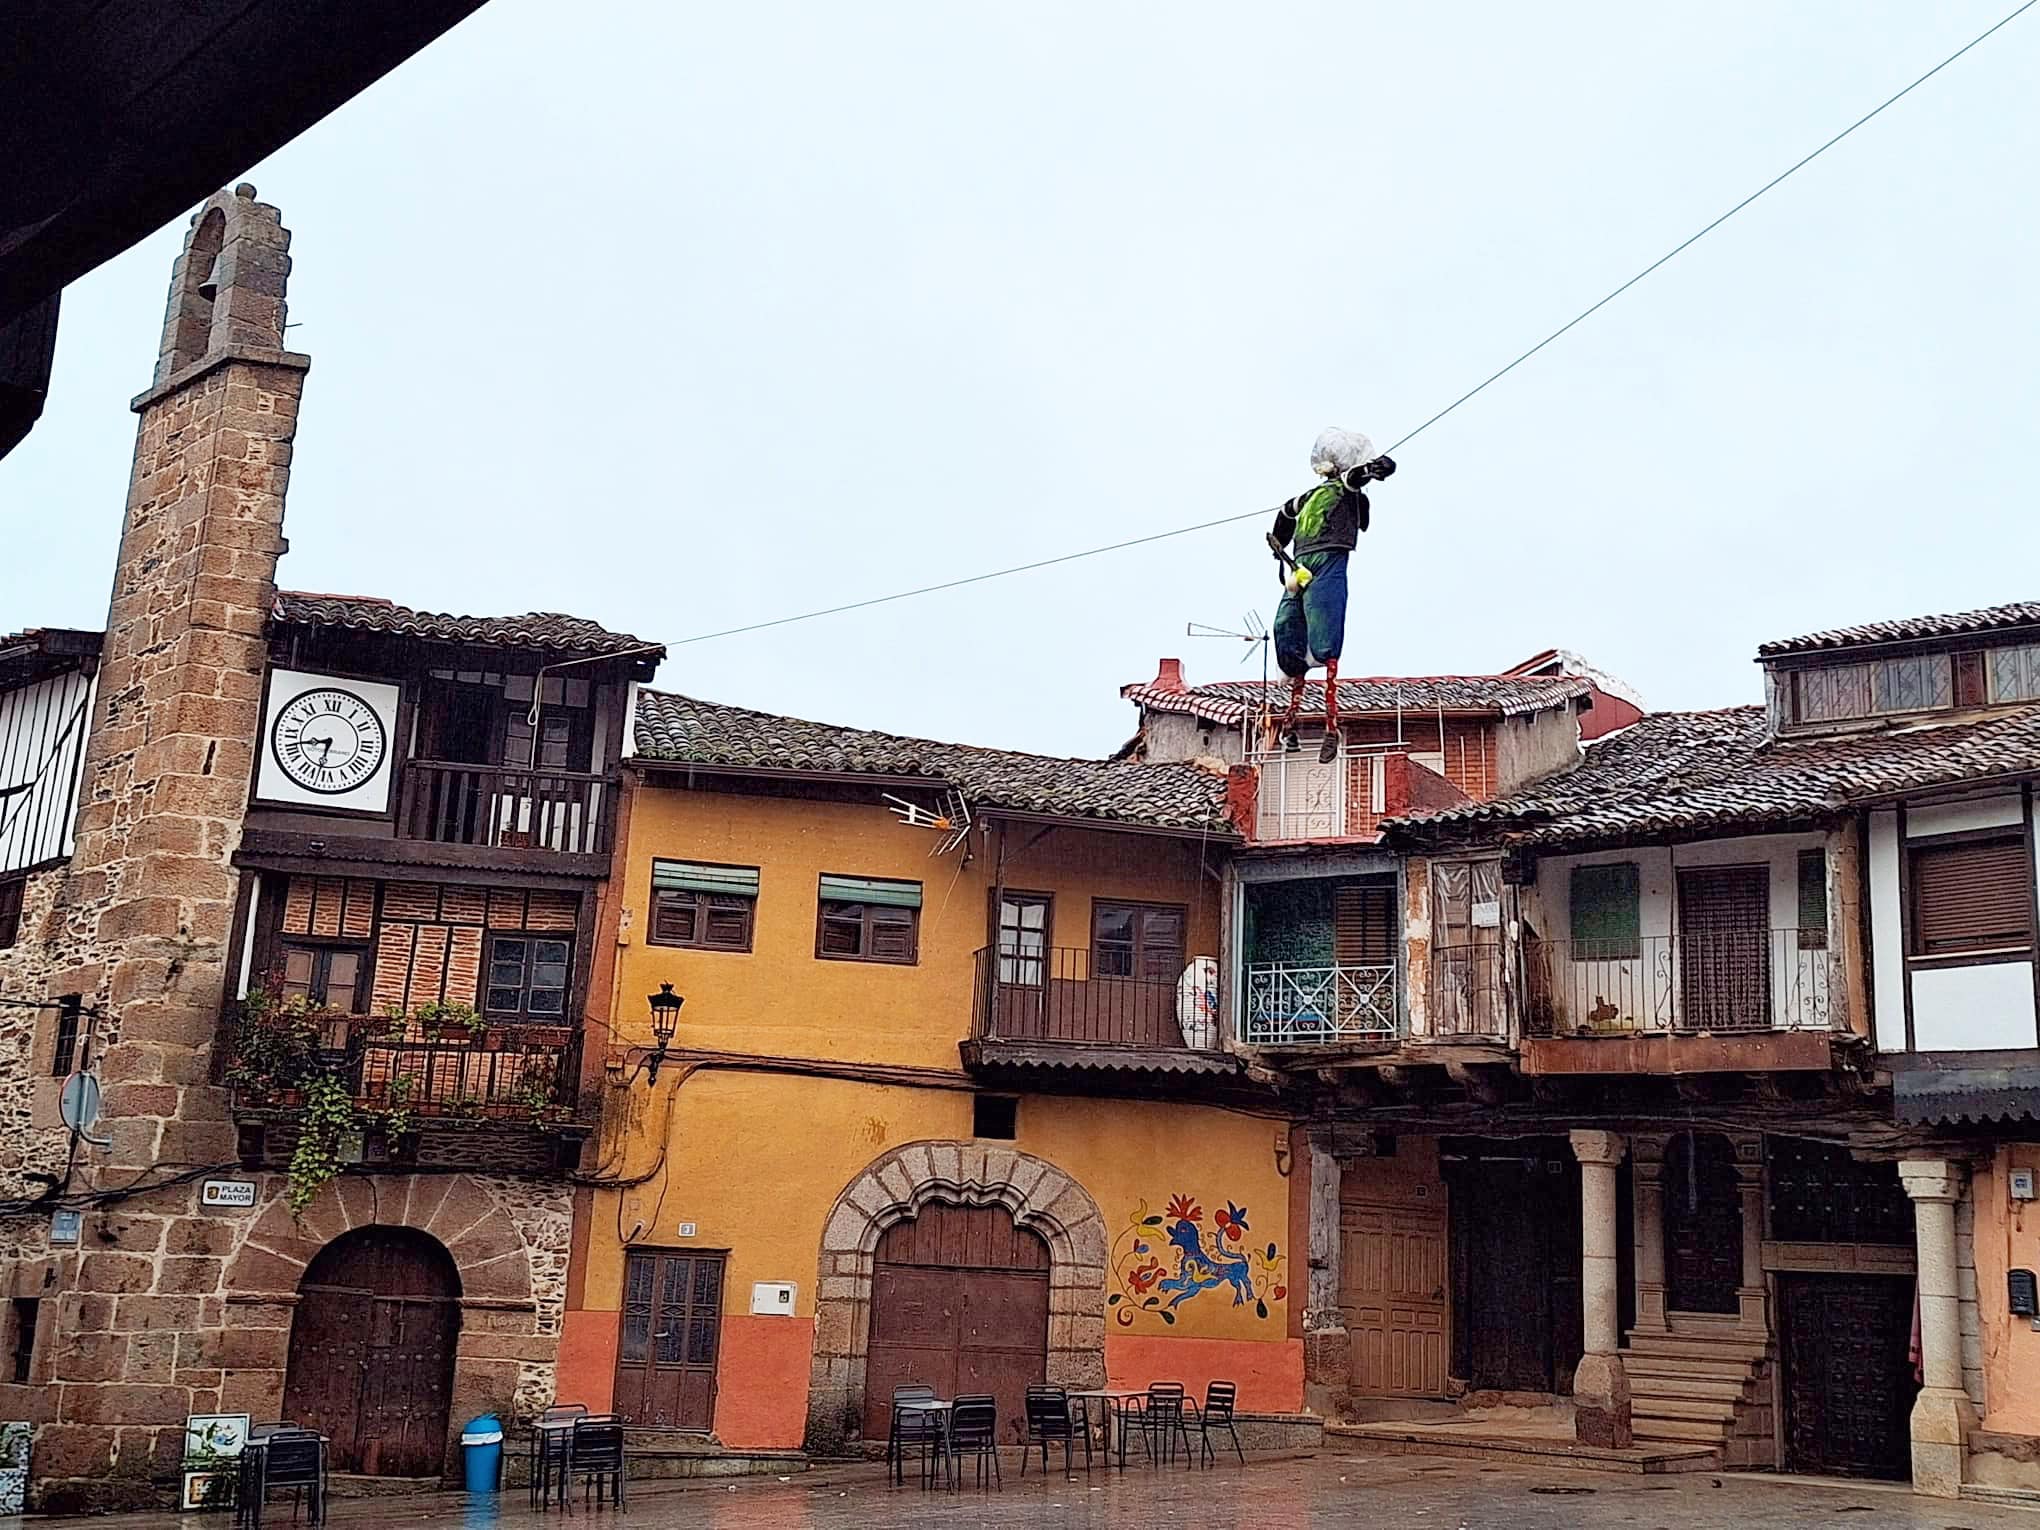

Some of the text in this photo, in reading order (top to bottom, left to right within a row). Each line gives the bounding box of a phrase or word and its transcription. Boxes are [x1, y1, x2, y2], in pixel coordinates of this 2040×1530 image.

[325, 700, 342, 713] XII
[360, 740, 374, 754] III
[222, 1186, 251, 1194] PLAZA
